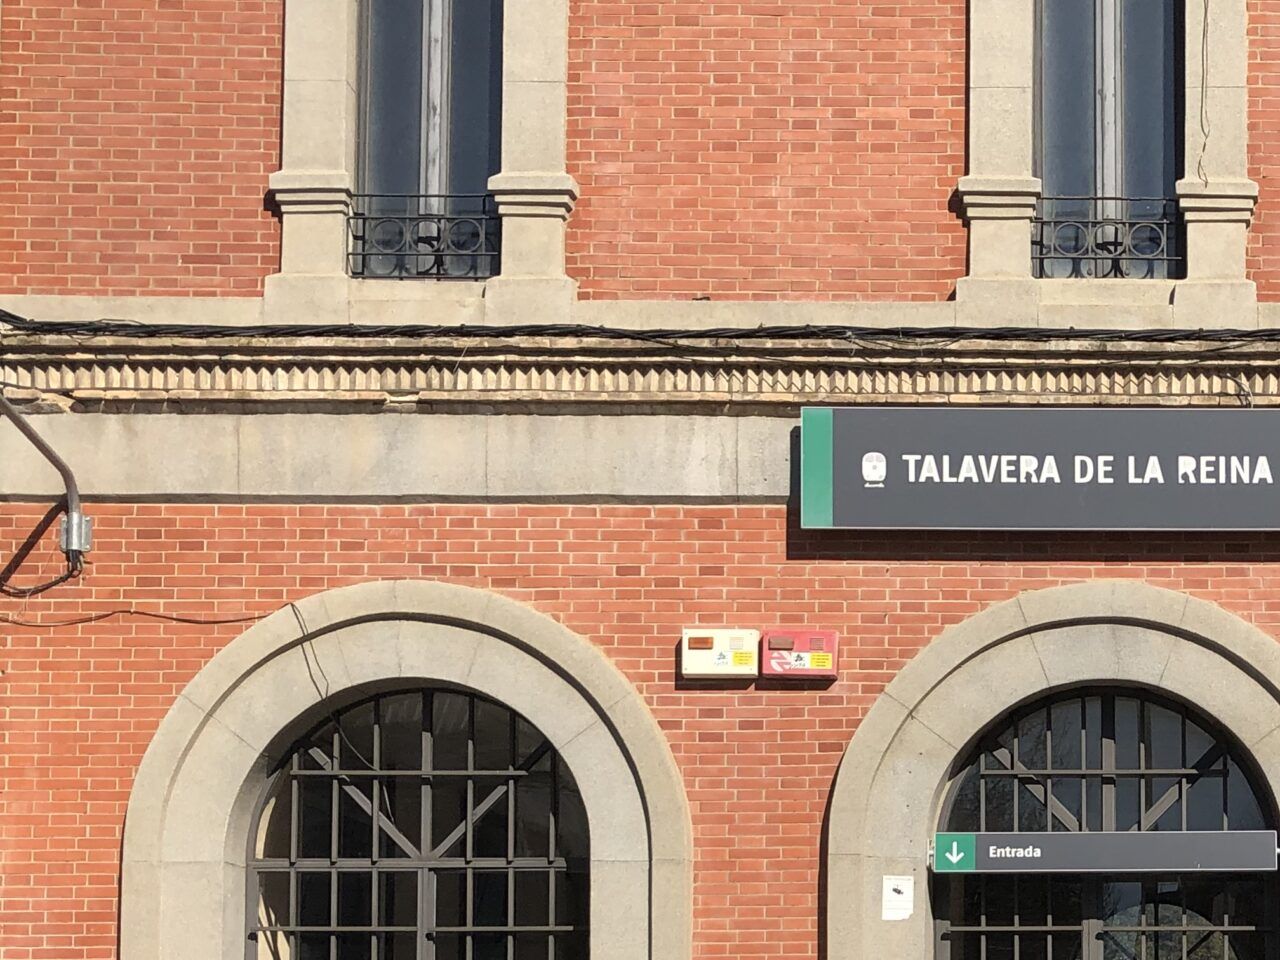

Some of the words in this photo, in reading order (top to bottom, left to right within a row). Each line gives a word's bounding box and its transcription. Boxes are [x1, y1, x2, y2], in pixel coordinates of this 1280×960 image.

[901, 454, 1061, 484] TALAVERA
[1074, 455, 1114, 484] DE
[1127, 455, 1165, 484] LA
[1177, 455, 1274, 484] REINA
[988, 845, 1042, 858] Entrada
